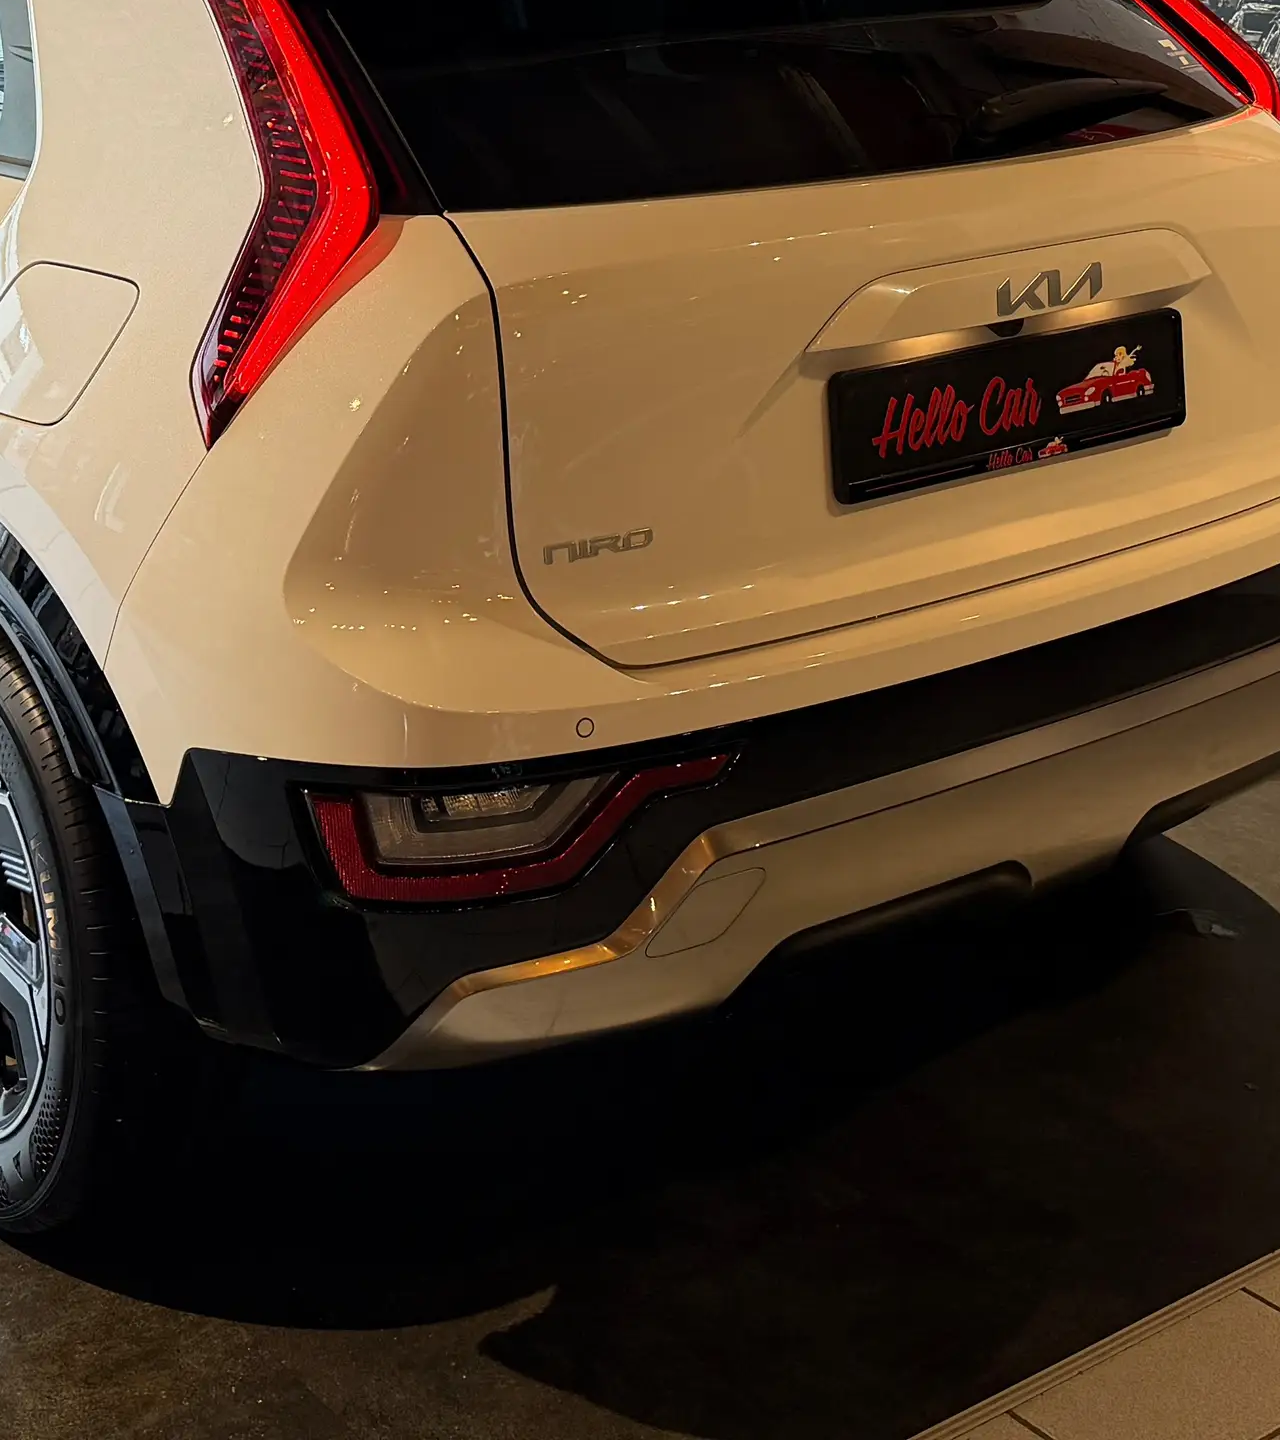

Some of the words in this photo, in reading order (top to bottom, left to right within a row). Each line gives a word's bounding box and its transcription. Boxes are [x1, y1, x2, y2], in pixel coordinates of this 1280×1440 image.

[872, 385, 975, 459] Hello
[979, 376, 1042, 436] Car
[542, 526, 654, 566] NIRO
